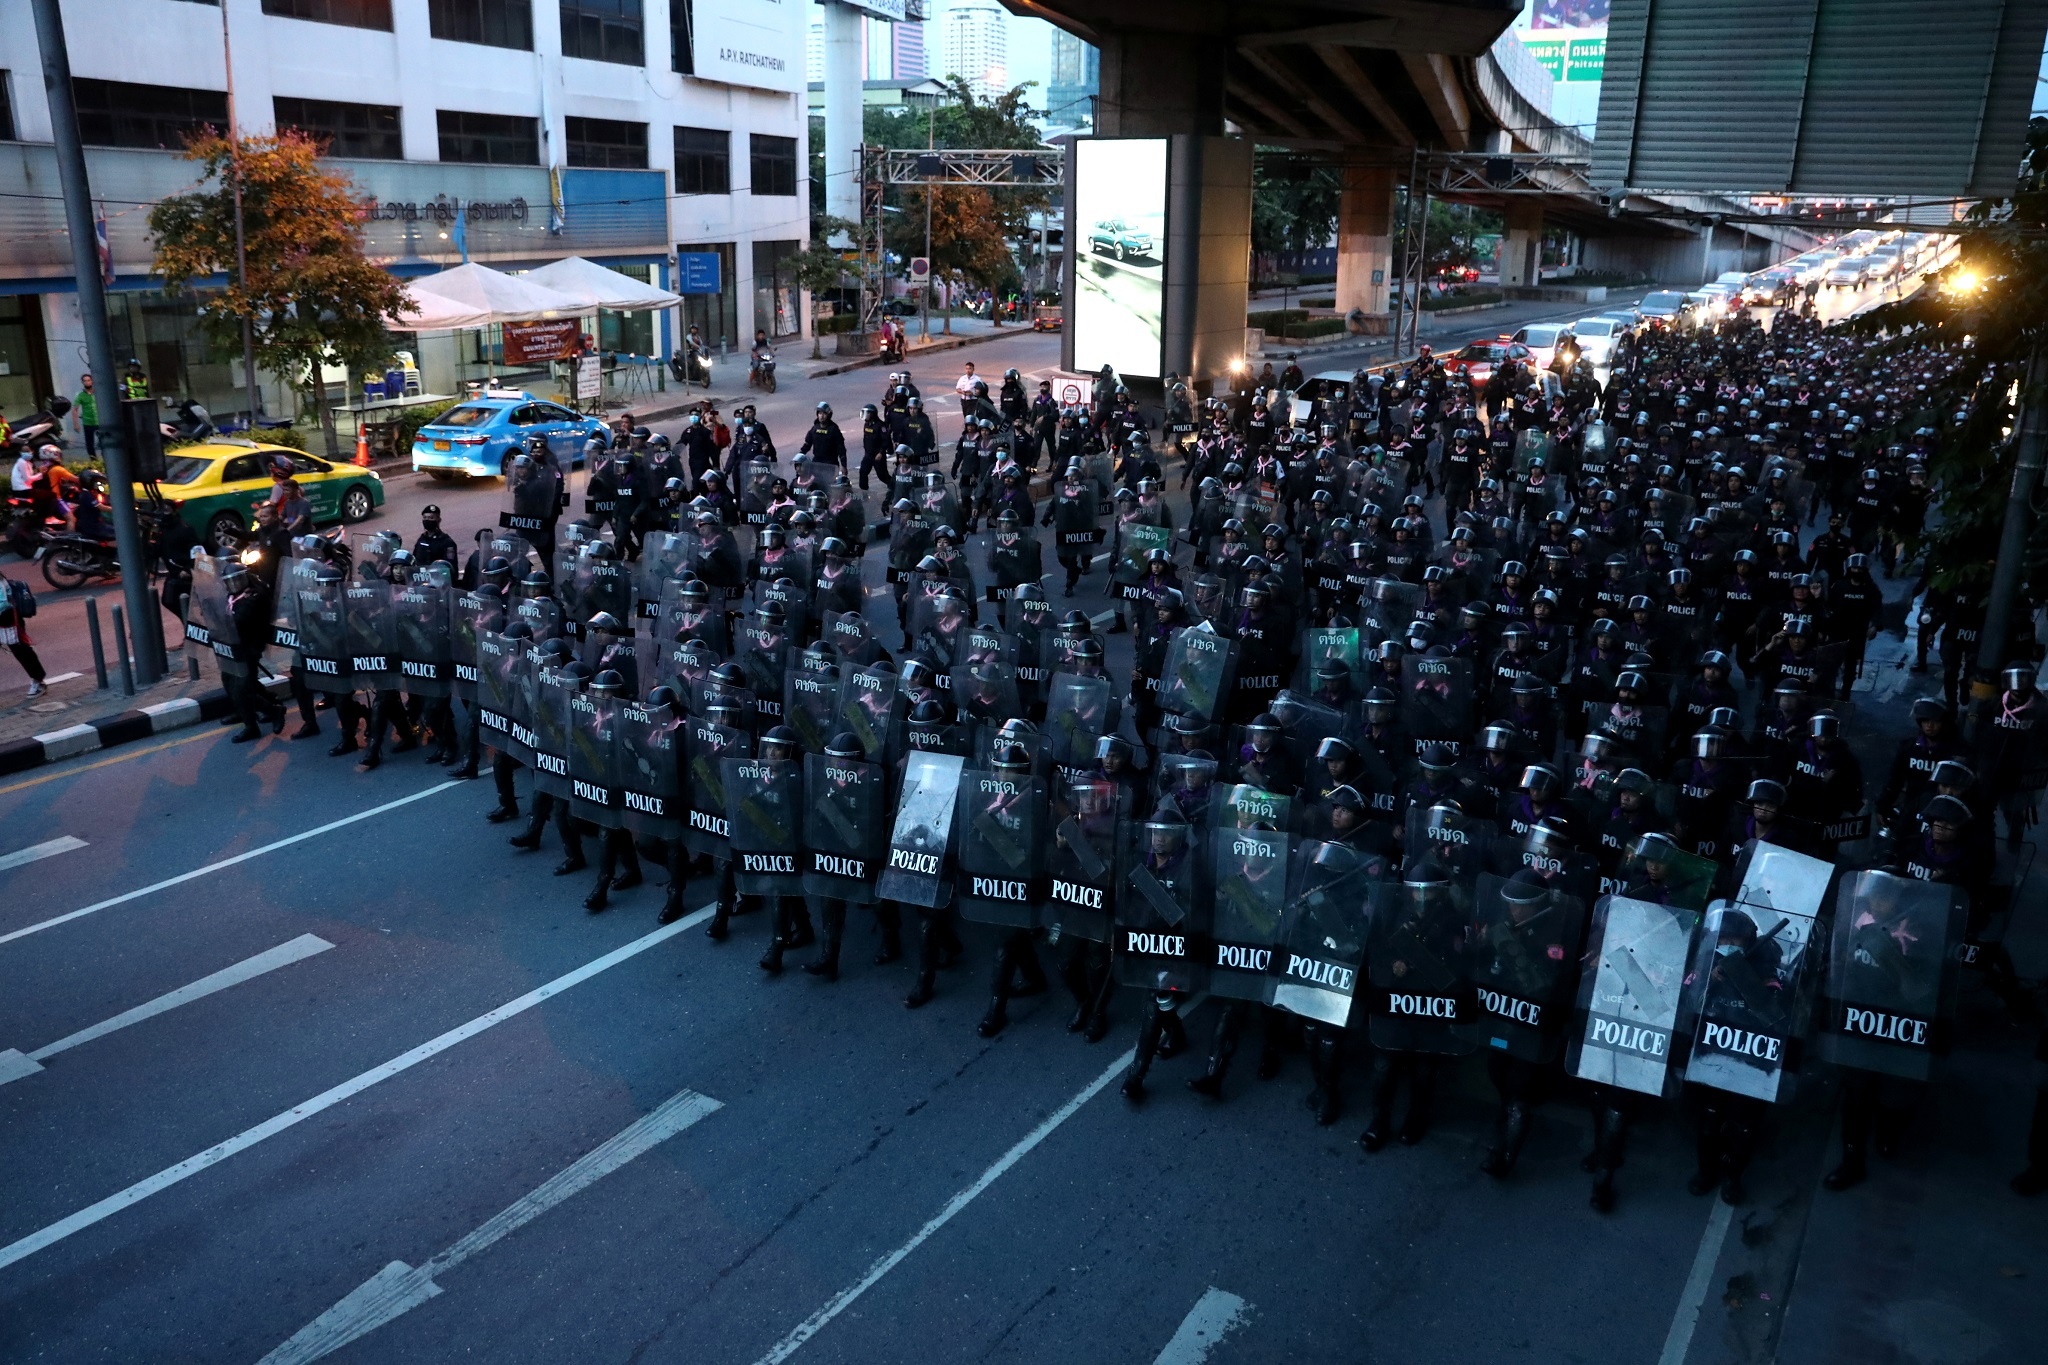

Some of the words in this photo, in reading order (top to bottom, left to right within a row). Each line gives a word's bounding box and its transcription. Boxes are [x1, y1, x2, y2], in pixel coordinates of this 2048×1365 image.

[1528, 46, 1565, 57] นหลวง
[720, 47, 738, 63] A.P.Y.
[740, 54, 785, 72] RATCHATHEWI
[1354, 411, 1372, 419] POLICE
[1172, 423, 1193, 432] POLICE
[919, 452, 938, 464] POLICE
[1387, 450, 1404, 458] POLICE
[1837, 450, 1855, 458] POLICE
[1582, 463, 1606, 473] POLICE
[595, 501, 616, 512] POLI
[1721, 501, 1742, 509] POLICE
[1858, 496, 1878, 506] POLICE
[510, 516, 542, 529] POLICE
[748, 512, 766, 523] POLI
[907, 519, 930, 529] ตชด.
[1065, 531, 1093, 543] POLICE
[592, 565, 618, 576] ตชด.
[1768, 571, 1793, 580] POLICE
[1319, 577, 1342, 591] POLI
[997, 588, 1016, 600] POL
[1123, 587, 1140, 598] POL
[1597, 591, 1625, 602] POLICE
[1726, 591, 1752, 601] POLICE
[459, 597, 483, 610] ตชด.
[518, 604, 542, 617] ตชด.
[1024, 600, 1052, 612] ตชด.
[1667, 605, 1696, 616] POLICE
[1415, 610, 1436, 620] POLIC
[1783, 612, 1812, 623] POLICE
[836, 621, 862, 638] ตชด.
[1366, 618, 1381, 629] POL
[186, 624, 210, 643] POLICE
[276, 630, 299, 648] POLI
[1318, 634, 1348, 645] ตชด.
[1956, 628, 1976, 642] POL
[212, 640, 234, 658] POLICE
[972, 636, 1001, 650] ตชด.
[1624, 641, 1648, 652] POLIC
[306, 658, 338, 674] POLICE
[353, 656, 387, 670] POLICE
[674, 651, 700, 667] ตชด.
[402, 660, 436, 679] POLICE
[456, 664, 477, 681] POLI
[1015, 666, 1048, 680] POLIC
[1418, 662, 1451, 675] ตชด.
[1780, 664, 1814, 676] POLICE
[853, 672, 883, 692] ตชด.
[936, 674, 951, 689] ICE
[1146, 678, 1170, 693] POLI
[1240, 675, 1279, 690] POLICE
[572, 699, 596, 714] ตชด.
[758, 702, 782, 716] LICE
[481, 709, 508, 732] POLICE
[623, 708, 651, 724] ตชด.
[698, 728, 726, 746] ตชด.
[909, 731, 944, 746] ตชด.
[537, 752, 566, 776] POLICE
[1909, 757, 1936, 772] POLI
[826, 766, 861, 784] ตชด.
[574, 780, 608, 805] POLICE
[980, 779, 1019, 795] ตชด.
[625, 791, 664, 815] POLICE
[1236, 798, 1277, 818] ตชด.
[1372, 791, 1394, 811] ICE
[690, 810, 730, 836] POLICE
[1822, 820, 1863, 841] POLICE
[1428, 826, 1469, 844] ตชด.
[1233, 840, 1276, 857] ตชด.
[744, 854, 794, 872] POLICE
[815, 853, 864, 879] POLICE
[890, 848, 938, 874] POLICE
[1522, 852, 1566, 876] ตชด.
[1907, 862, 1932, 881] POL
[972, 877, 1027, 901] POLICE
[1599, 876, 1628, 895] POL
[1052, 879, 1103, 909] POLICE
[1128, 932, 1185, 956] POLICE
[1286, 954, 1352, 990] POLICE
[1389, 994, 1456, 1019] POLICE
[1478, 987, 1540, 1026] POLICE
[1844, 1007, 1928, 1045] POLICE
[1591, 1018, 1666, 1057] POLICE
[1702, 1022, 1781, 1062] POLICE
